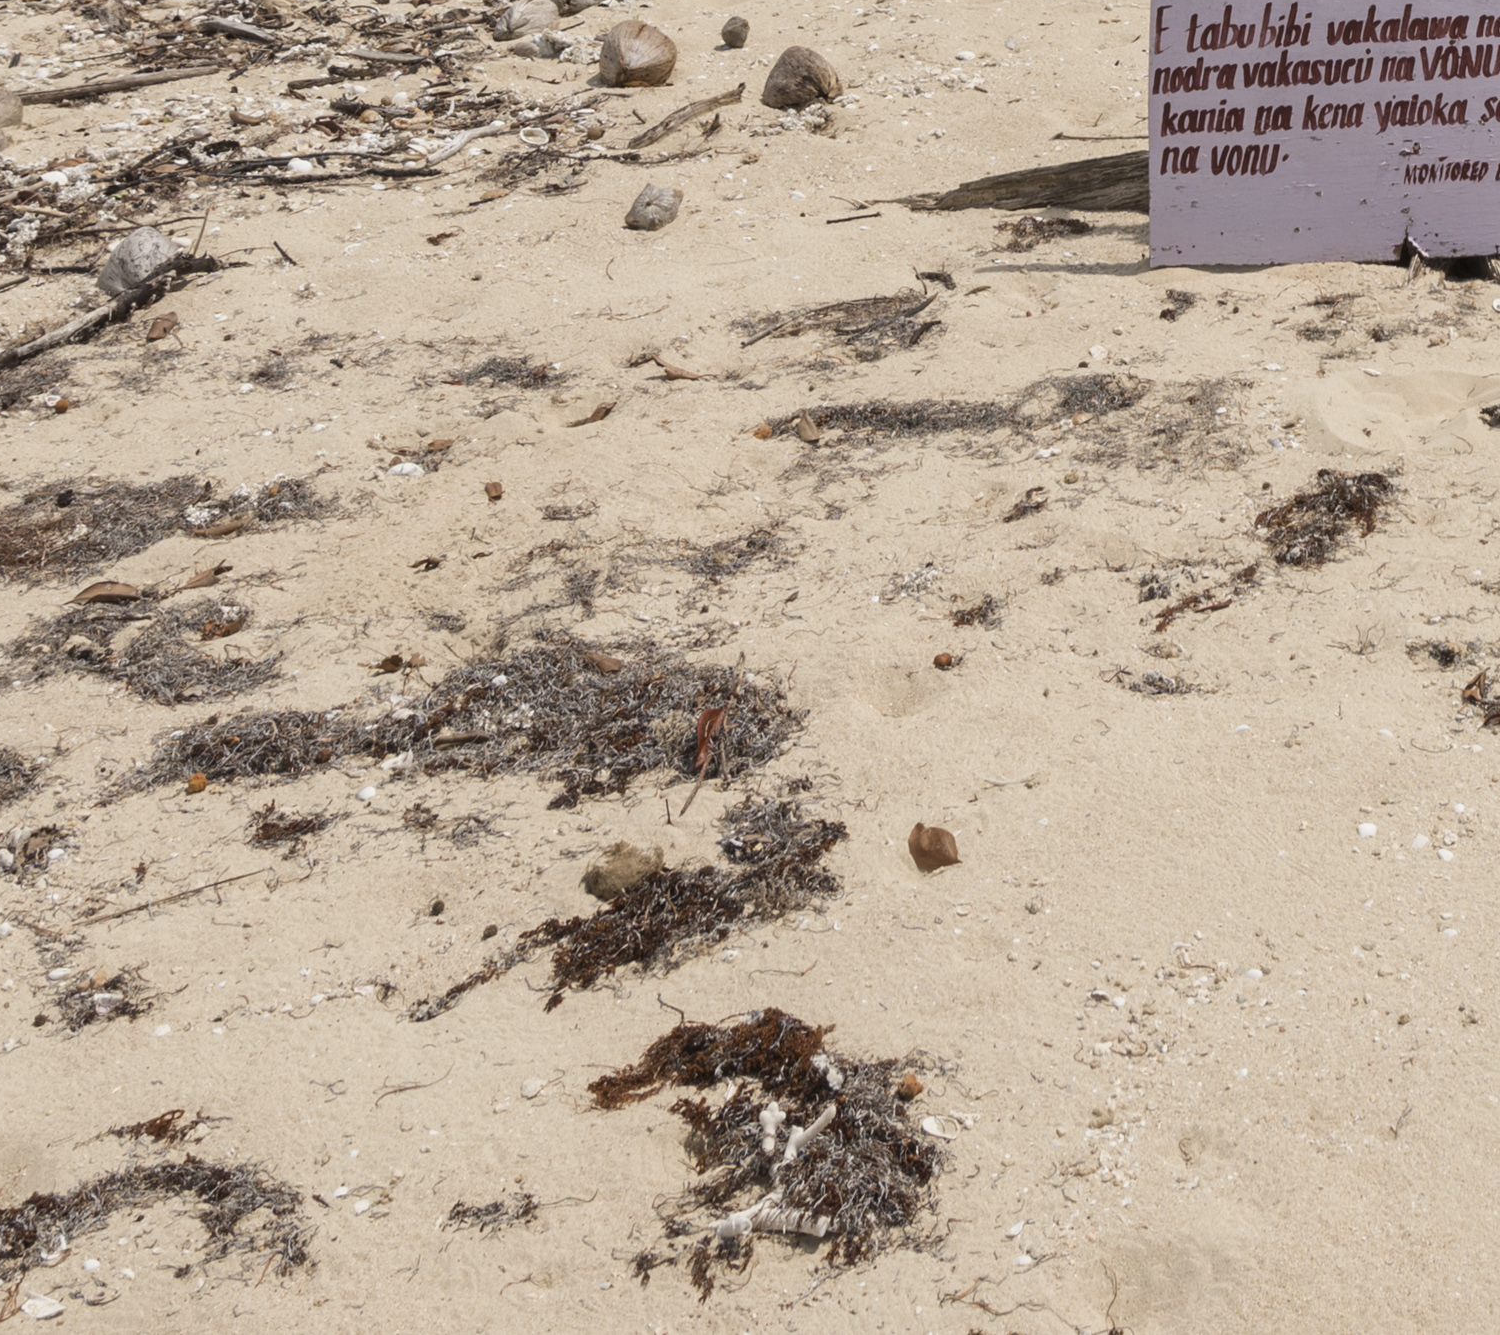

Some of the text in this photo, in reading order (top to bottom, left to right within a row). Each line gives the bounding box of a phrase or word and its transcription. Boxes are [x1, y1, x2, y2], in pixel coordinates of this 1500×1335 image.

[1153, 4, 1172, 55] E
[1185, 4, 1255, 53] tabu
[1257, 2, 1312, 49] bibi
[1326, 3, 1469, 46] vakalawa
[1152, 56, 1237, 95] nodra
[1379, 55, 1416, 82] na
[1160, 99, 1245, 137] kania
[1253, 105, 1293, 135] na
[1302, 94, 1365, 131] kena
[1160, 143, 1290, 176] na vonu.
[1404, 156, 1489, 184] MONITORED
